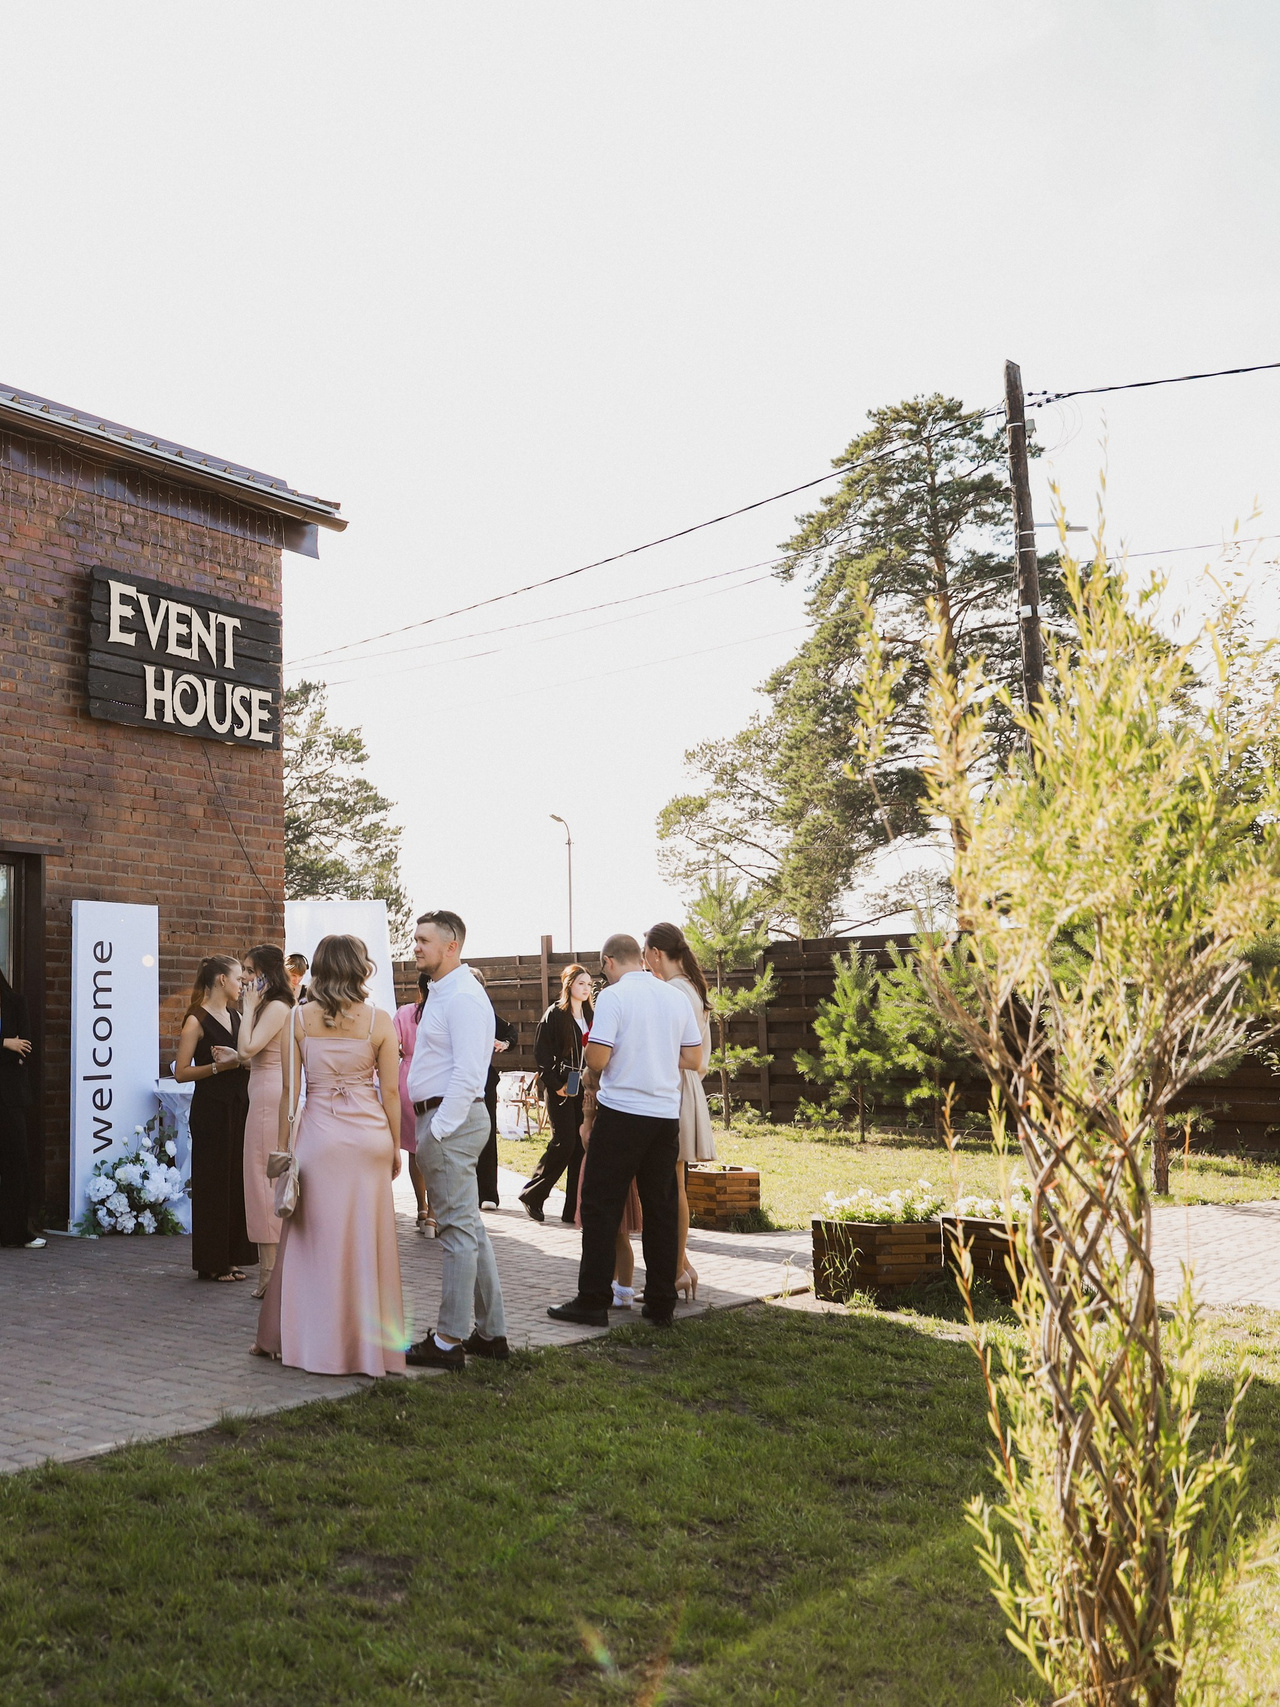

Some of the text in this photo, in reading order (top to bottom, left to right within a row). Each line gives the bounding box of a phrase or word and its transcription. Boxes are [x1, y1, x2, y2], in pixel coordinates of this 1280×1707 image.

[107, 579, 242, 670] EVENT
[143, 664, 273, 743] HOUSE
[82, 940, 113, 1154] welcome
